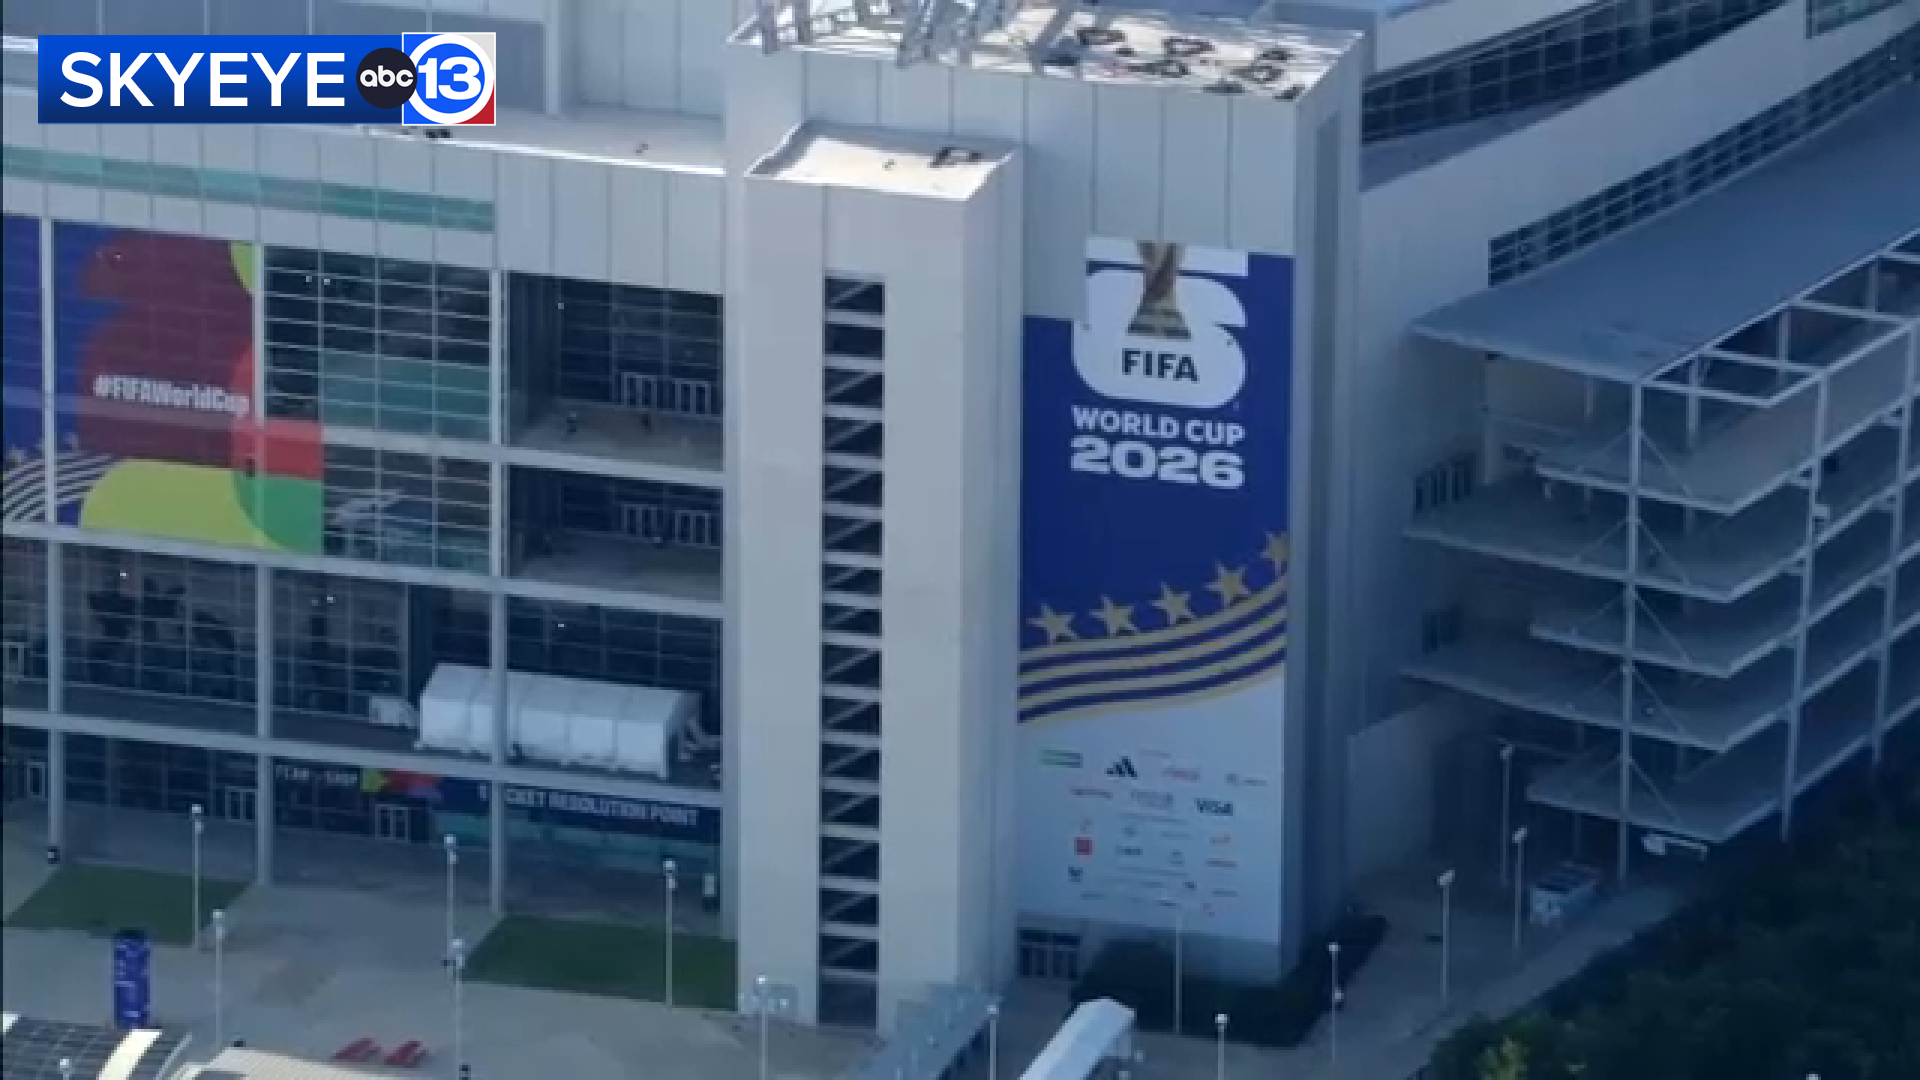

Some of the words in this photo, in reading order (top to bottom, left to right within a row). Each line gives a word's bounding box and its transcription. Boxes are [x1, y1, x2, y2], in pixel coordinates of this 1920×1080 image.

[1121, 348, 1200, 384] FIFA
[93, 375, 250, 420] #FIFAWorldCup
[1071, 405, 1180, 439] WORLD
[1184, 419, 1246, 447] CUP
[1070, 435, 1246, 490] 2026
